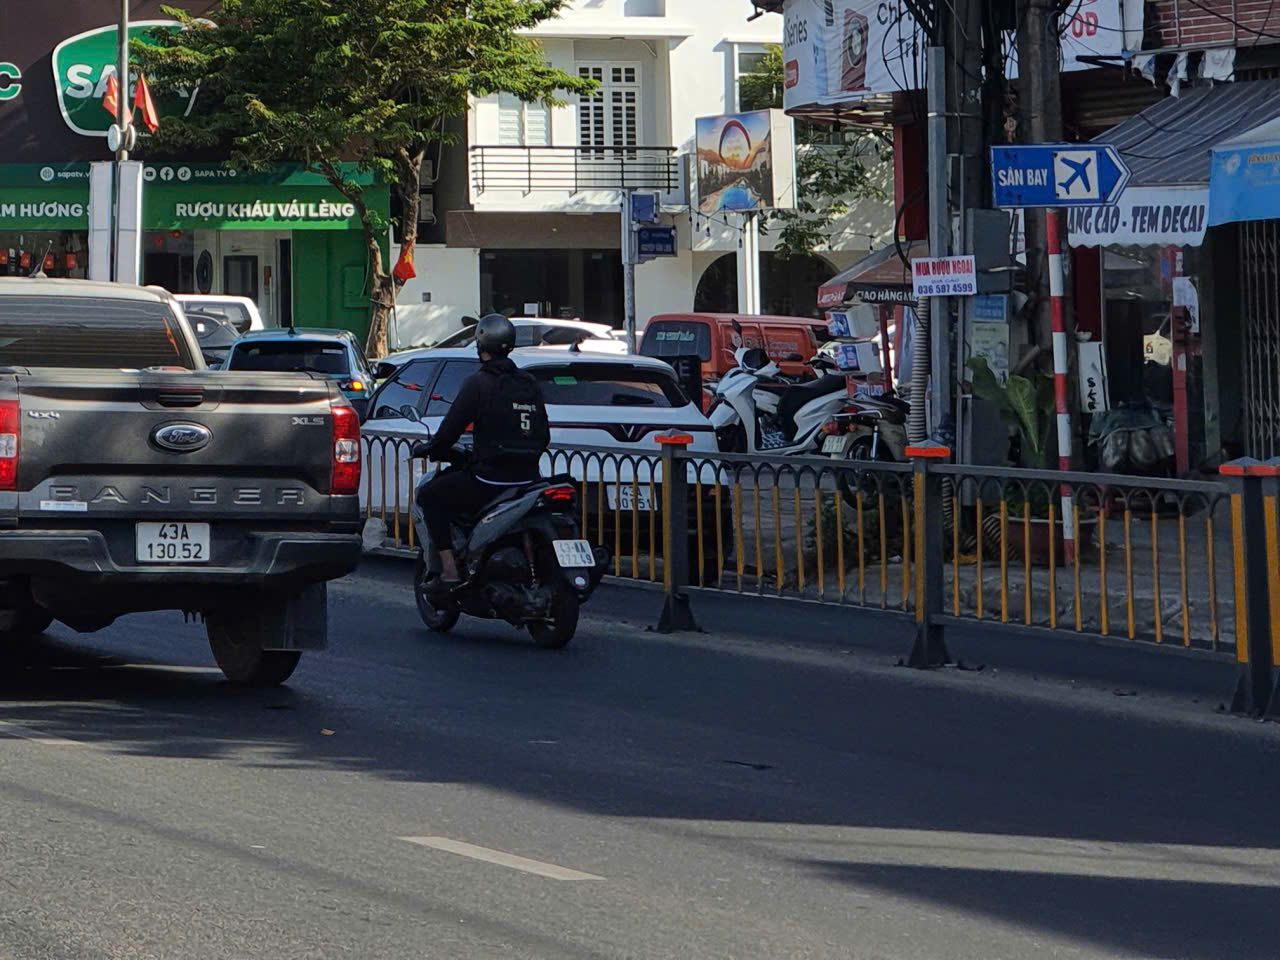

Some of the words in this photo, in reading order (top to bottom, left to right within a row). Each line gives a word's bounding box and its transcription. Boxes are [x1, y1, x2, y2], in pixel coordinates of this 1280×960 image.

[57, 171, 90, 179] sapatv.v
[998, 167, 1023, 187] SÂN
[1026, 168, 1048, 187] BAY
[19, 200, 83, 218] HƯƠNG
[176, 201, 224, 221] RƯỢU
[227, 200, 274, 217] KHÁU
[277, 199, 305, 217] VÁI
[308, 198, 355, 217] LÈNG
[1131, 206, 1161, 233] TEM
[915, 262, 930, 276] MUA
[878, 288, 902, 301] HÀNG
[918, 285, 933, 295] 036
[952, 283, 973, 293] 4599
[291, 416, 324, 426] XLS
[520, 412, 530, 431] 5
[170, 429, 198, 443] Ford
[49, 485, 305, 504] RANGER
[159, 524, 189, 540] 43A
[147, 543, 203, 559] 130.52
